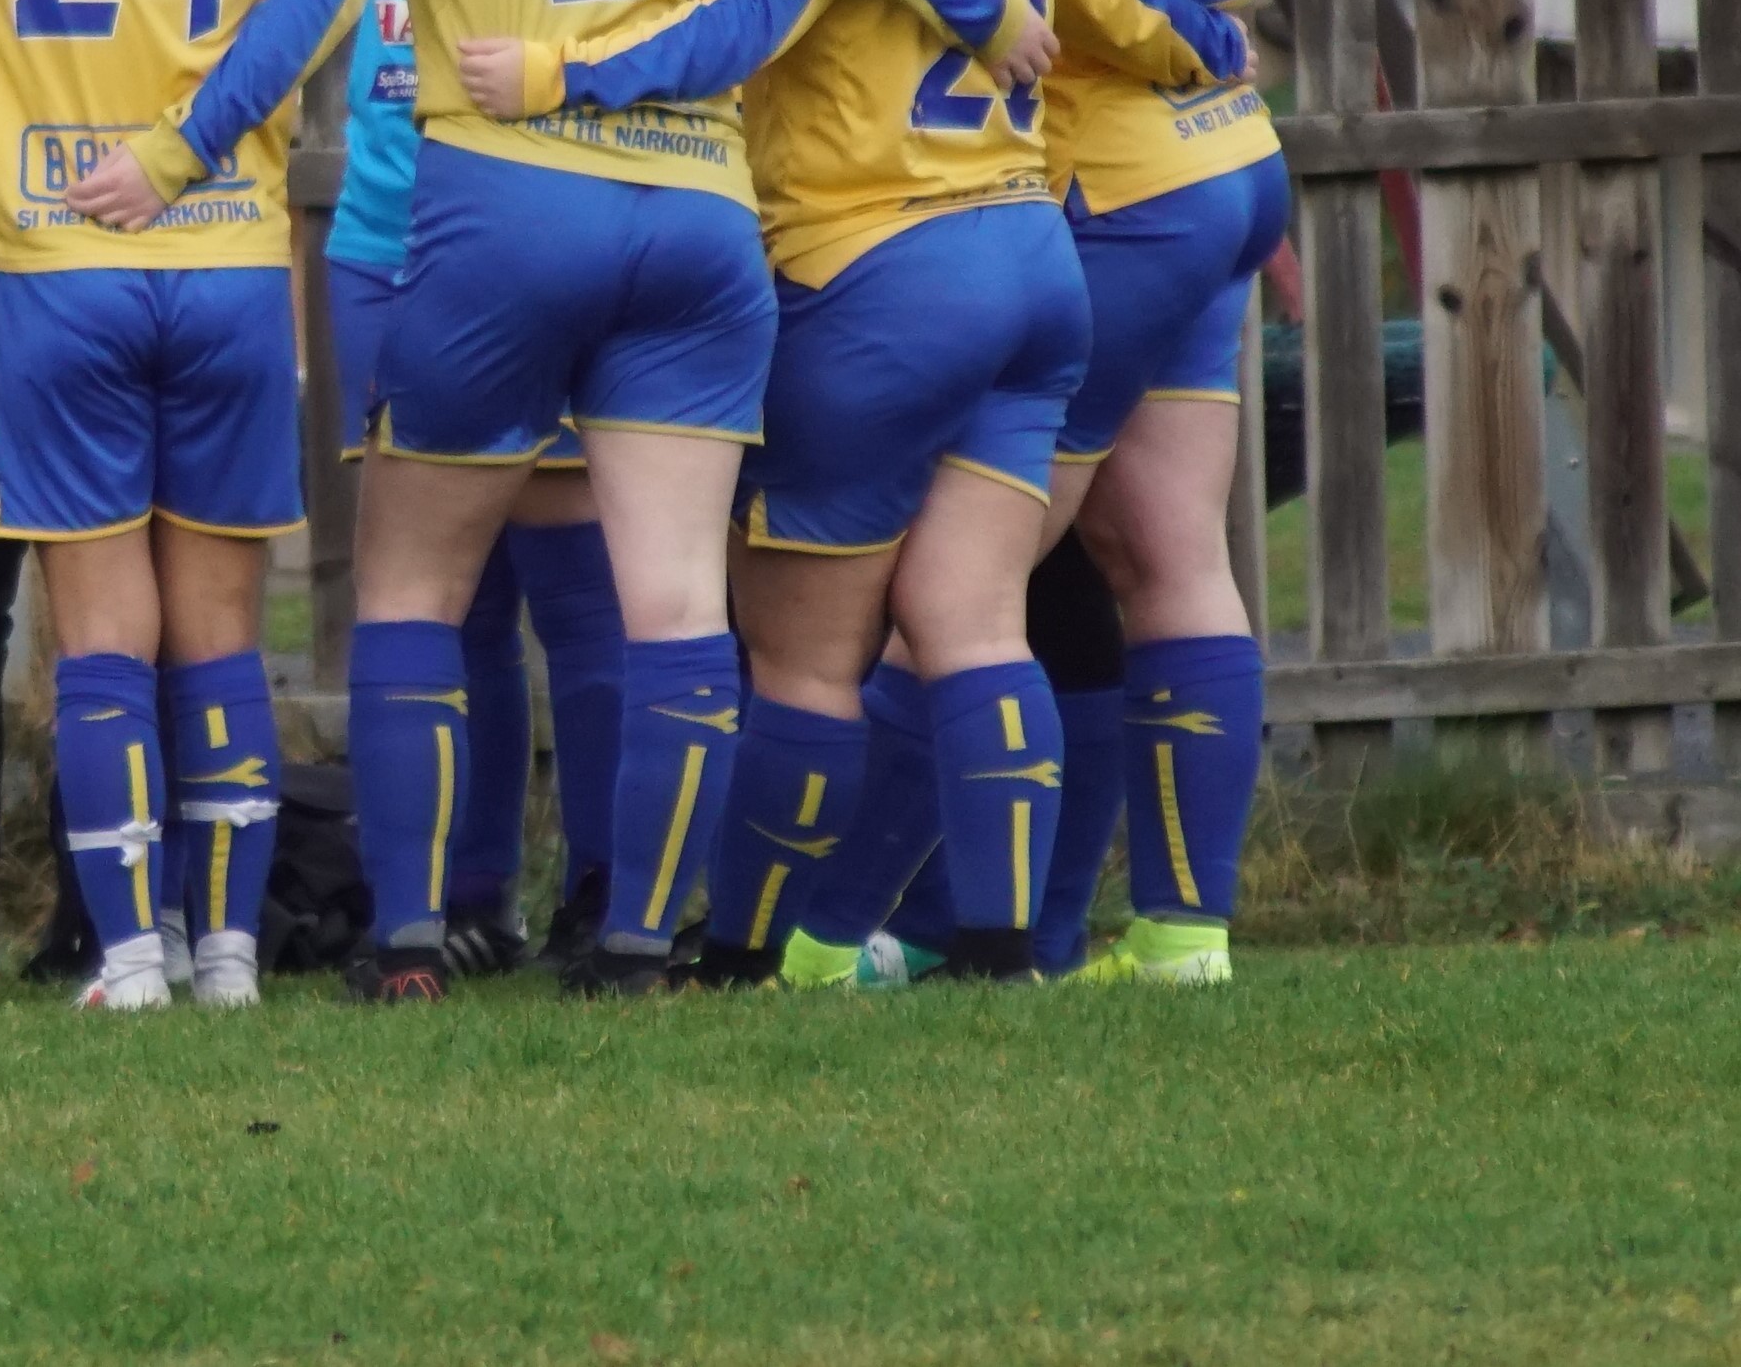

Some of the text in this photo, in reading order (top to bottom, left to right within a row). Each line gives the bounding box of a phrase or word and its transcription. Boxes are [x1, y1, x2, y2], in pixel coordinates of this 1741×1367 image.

[615, 125, 728, 167] NARKOTIKA
[45, 137, 123, 191] BR
[17, 210, 39, 230] SI
[148, 200, 260, 229] ARKOTIKA
